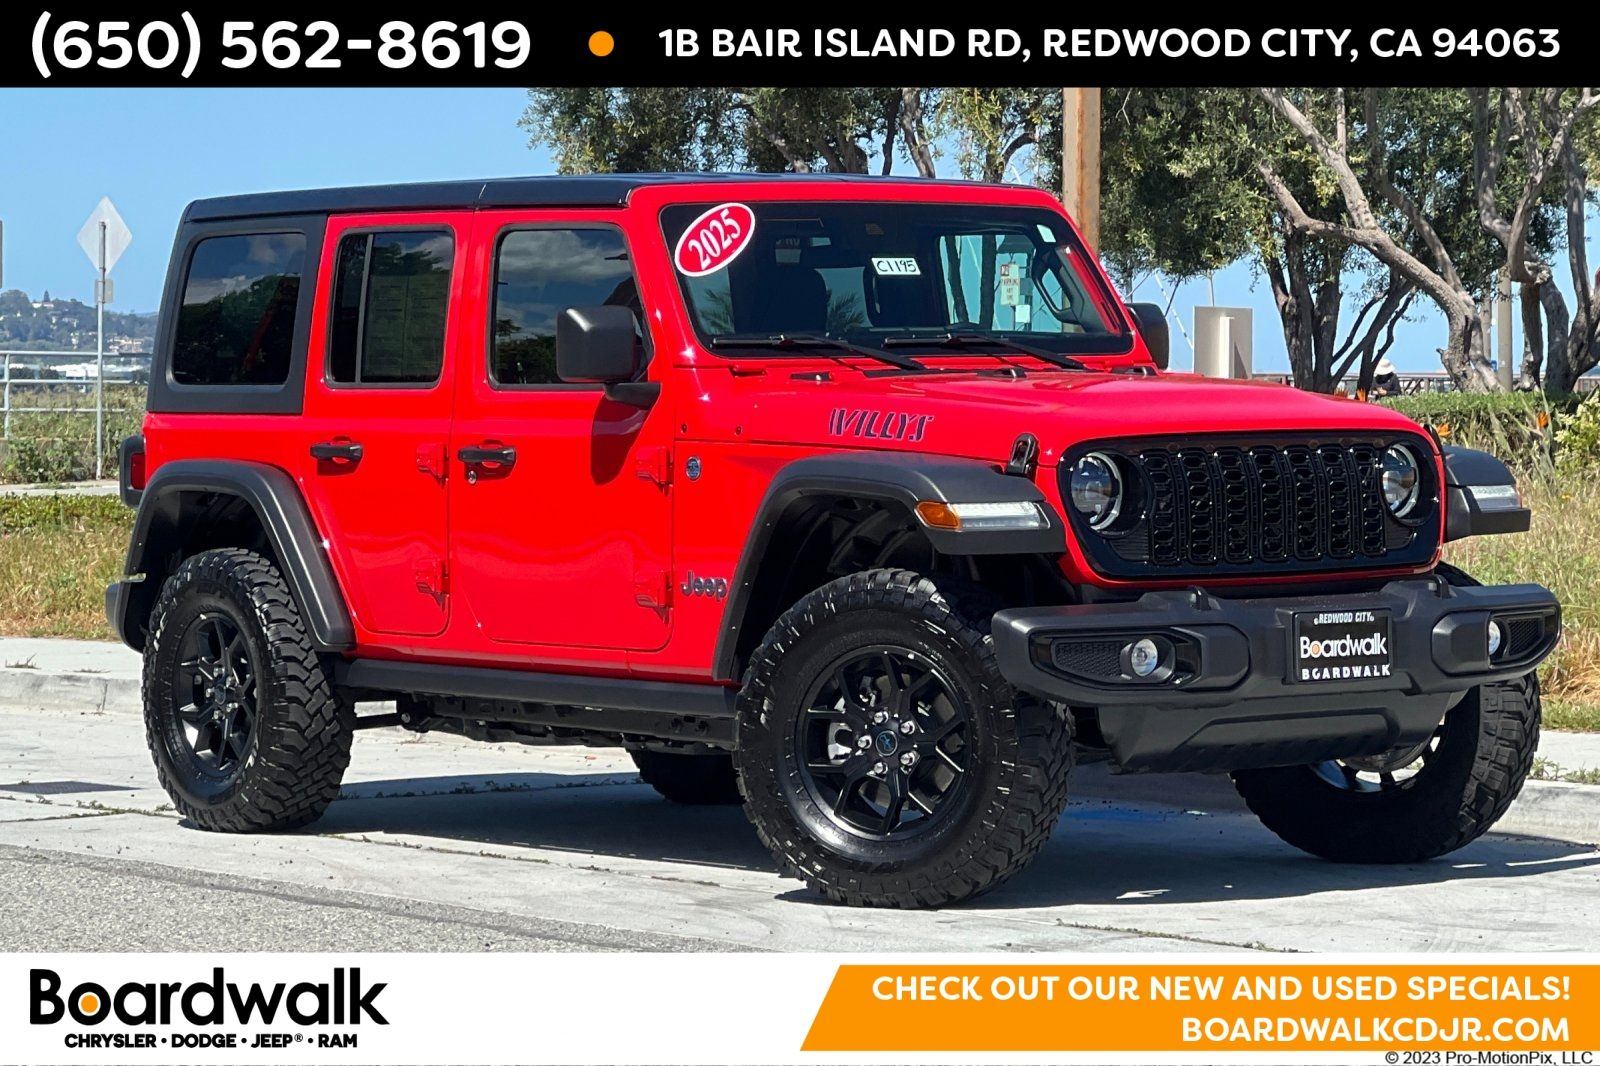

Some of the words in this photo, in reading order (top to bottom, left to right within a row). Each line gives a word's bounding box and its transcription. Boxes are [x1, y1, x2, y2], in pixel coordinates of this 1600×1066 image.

[688, 208, 741, 271] 2025
[876, 260, 917, 272] C1195
[829, 408, 935, 442] WILLYS
[680, 570, 727, 602] Jeep
[1318, 612, 1353, 624] REDWOOD
[1355, 611, 1372, 623] CITY
[1300, 632, 1388, 659] Boardwalk
[1301, 664, 1391, 680] BOARDWALK
